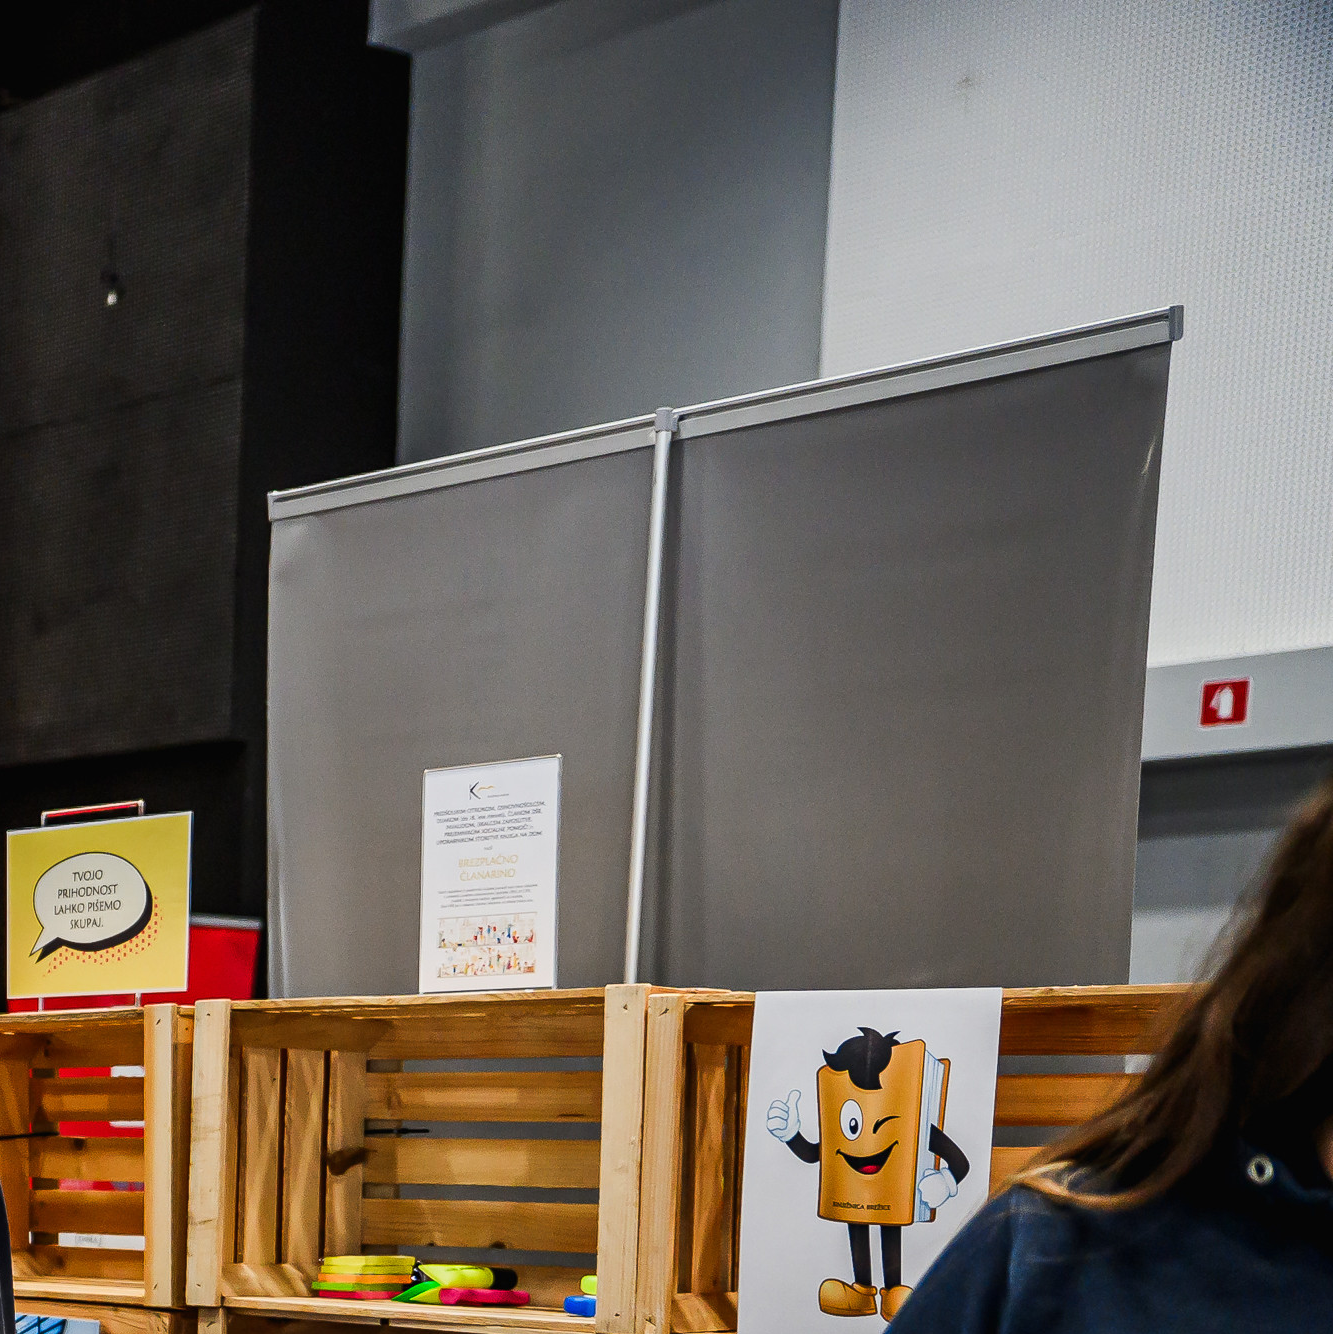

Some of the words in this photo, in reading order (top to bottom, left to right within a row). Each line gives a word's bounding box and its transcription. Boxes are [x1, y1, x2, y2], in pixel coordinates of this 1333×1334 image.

[72, 870, 103, 882] TVOJO
[57, 884, 118, 899] PRIHODNOST
[54, 902, 84, 915] LAHKO
[87, 899, 121, 912] PIŠEMO
[70, 917, 104, 930] SKUPAJ.
